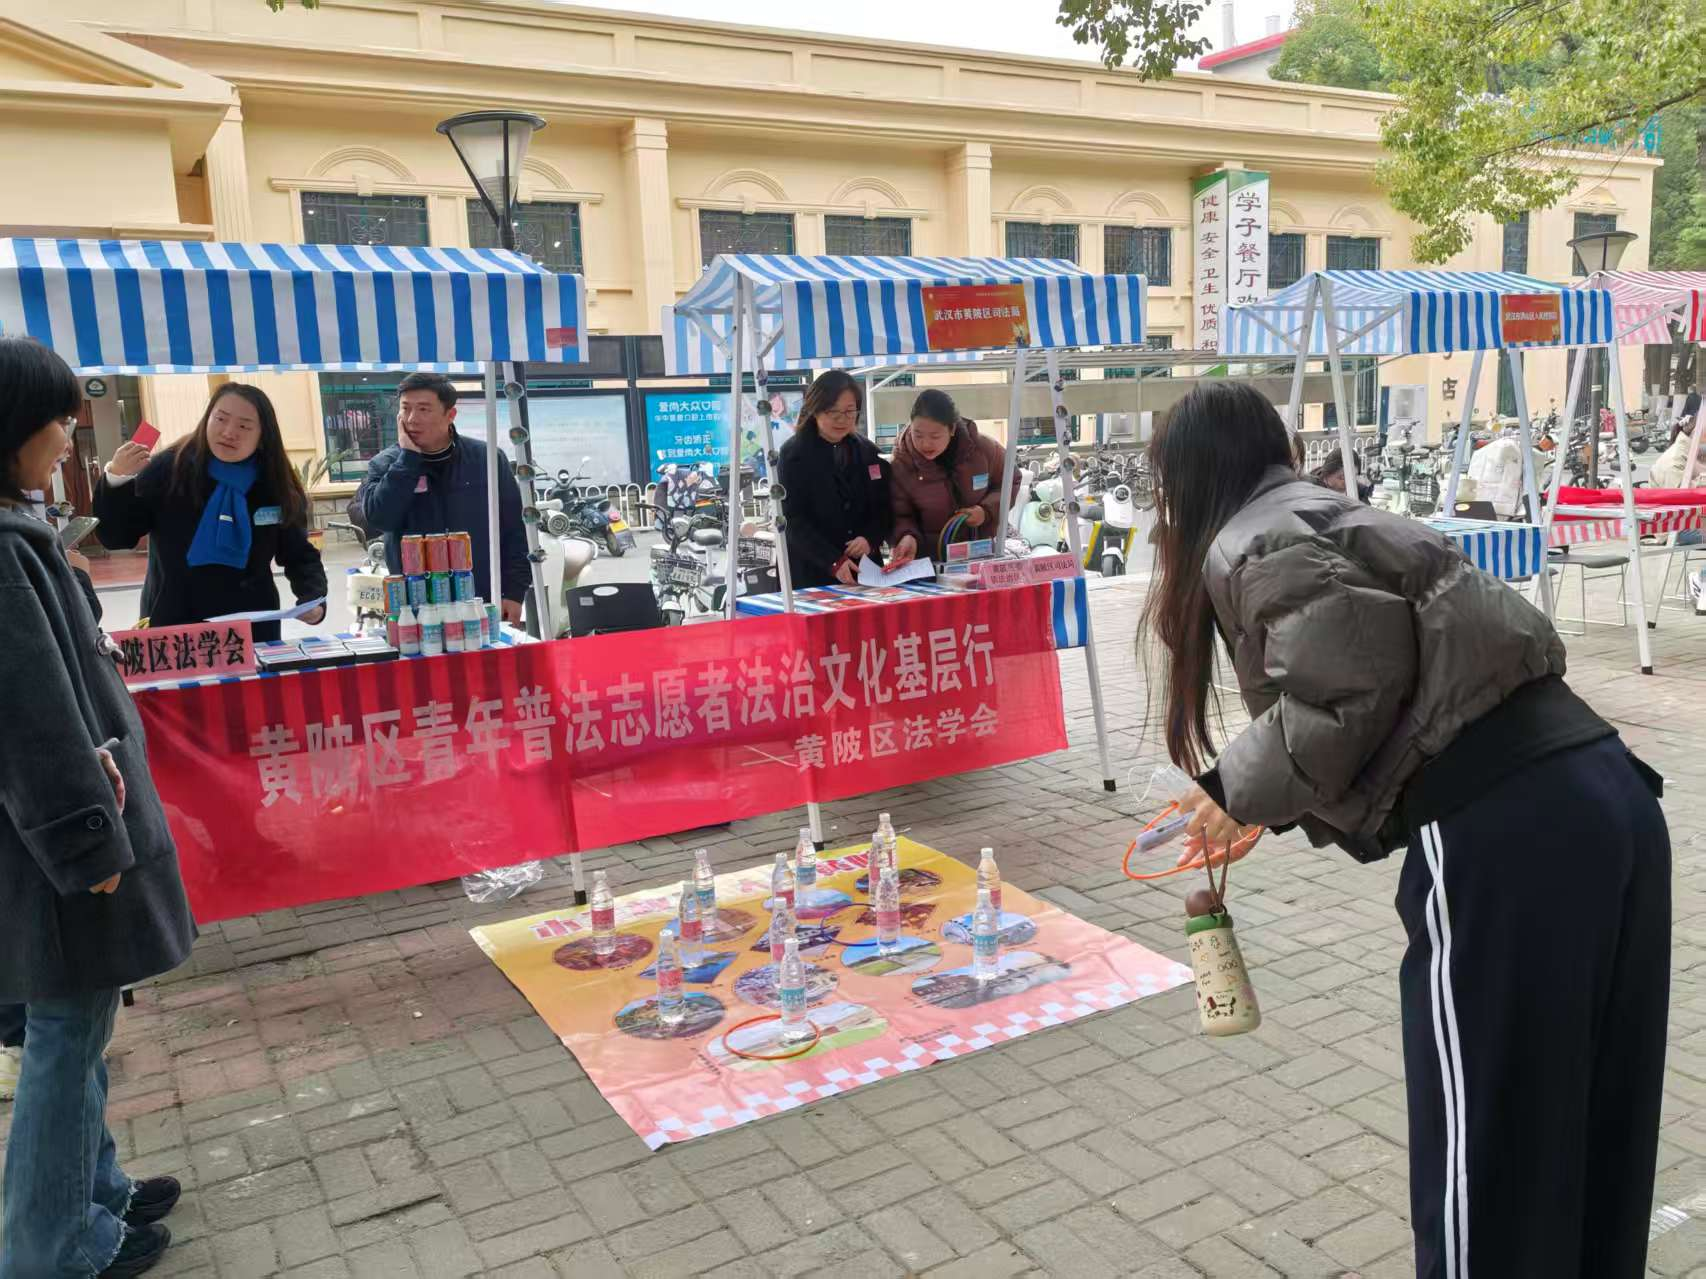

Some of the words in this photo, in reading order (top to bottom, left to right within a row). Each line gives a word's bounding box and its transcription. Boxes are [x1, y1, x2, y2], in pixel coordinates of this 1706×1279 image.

[1200, 194, 1219, 224] 健康
[1200, 231, 1219, 261] 安全
[1200, 267, 1219, 296] 卫生
[1200, 303, 1218, 332] 优质
[250, 623, 995, 808] 黄陂区青年普法志愿者法治文化基层行
[794, 702, 1000, 773] 黄陂区法学会
